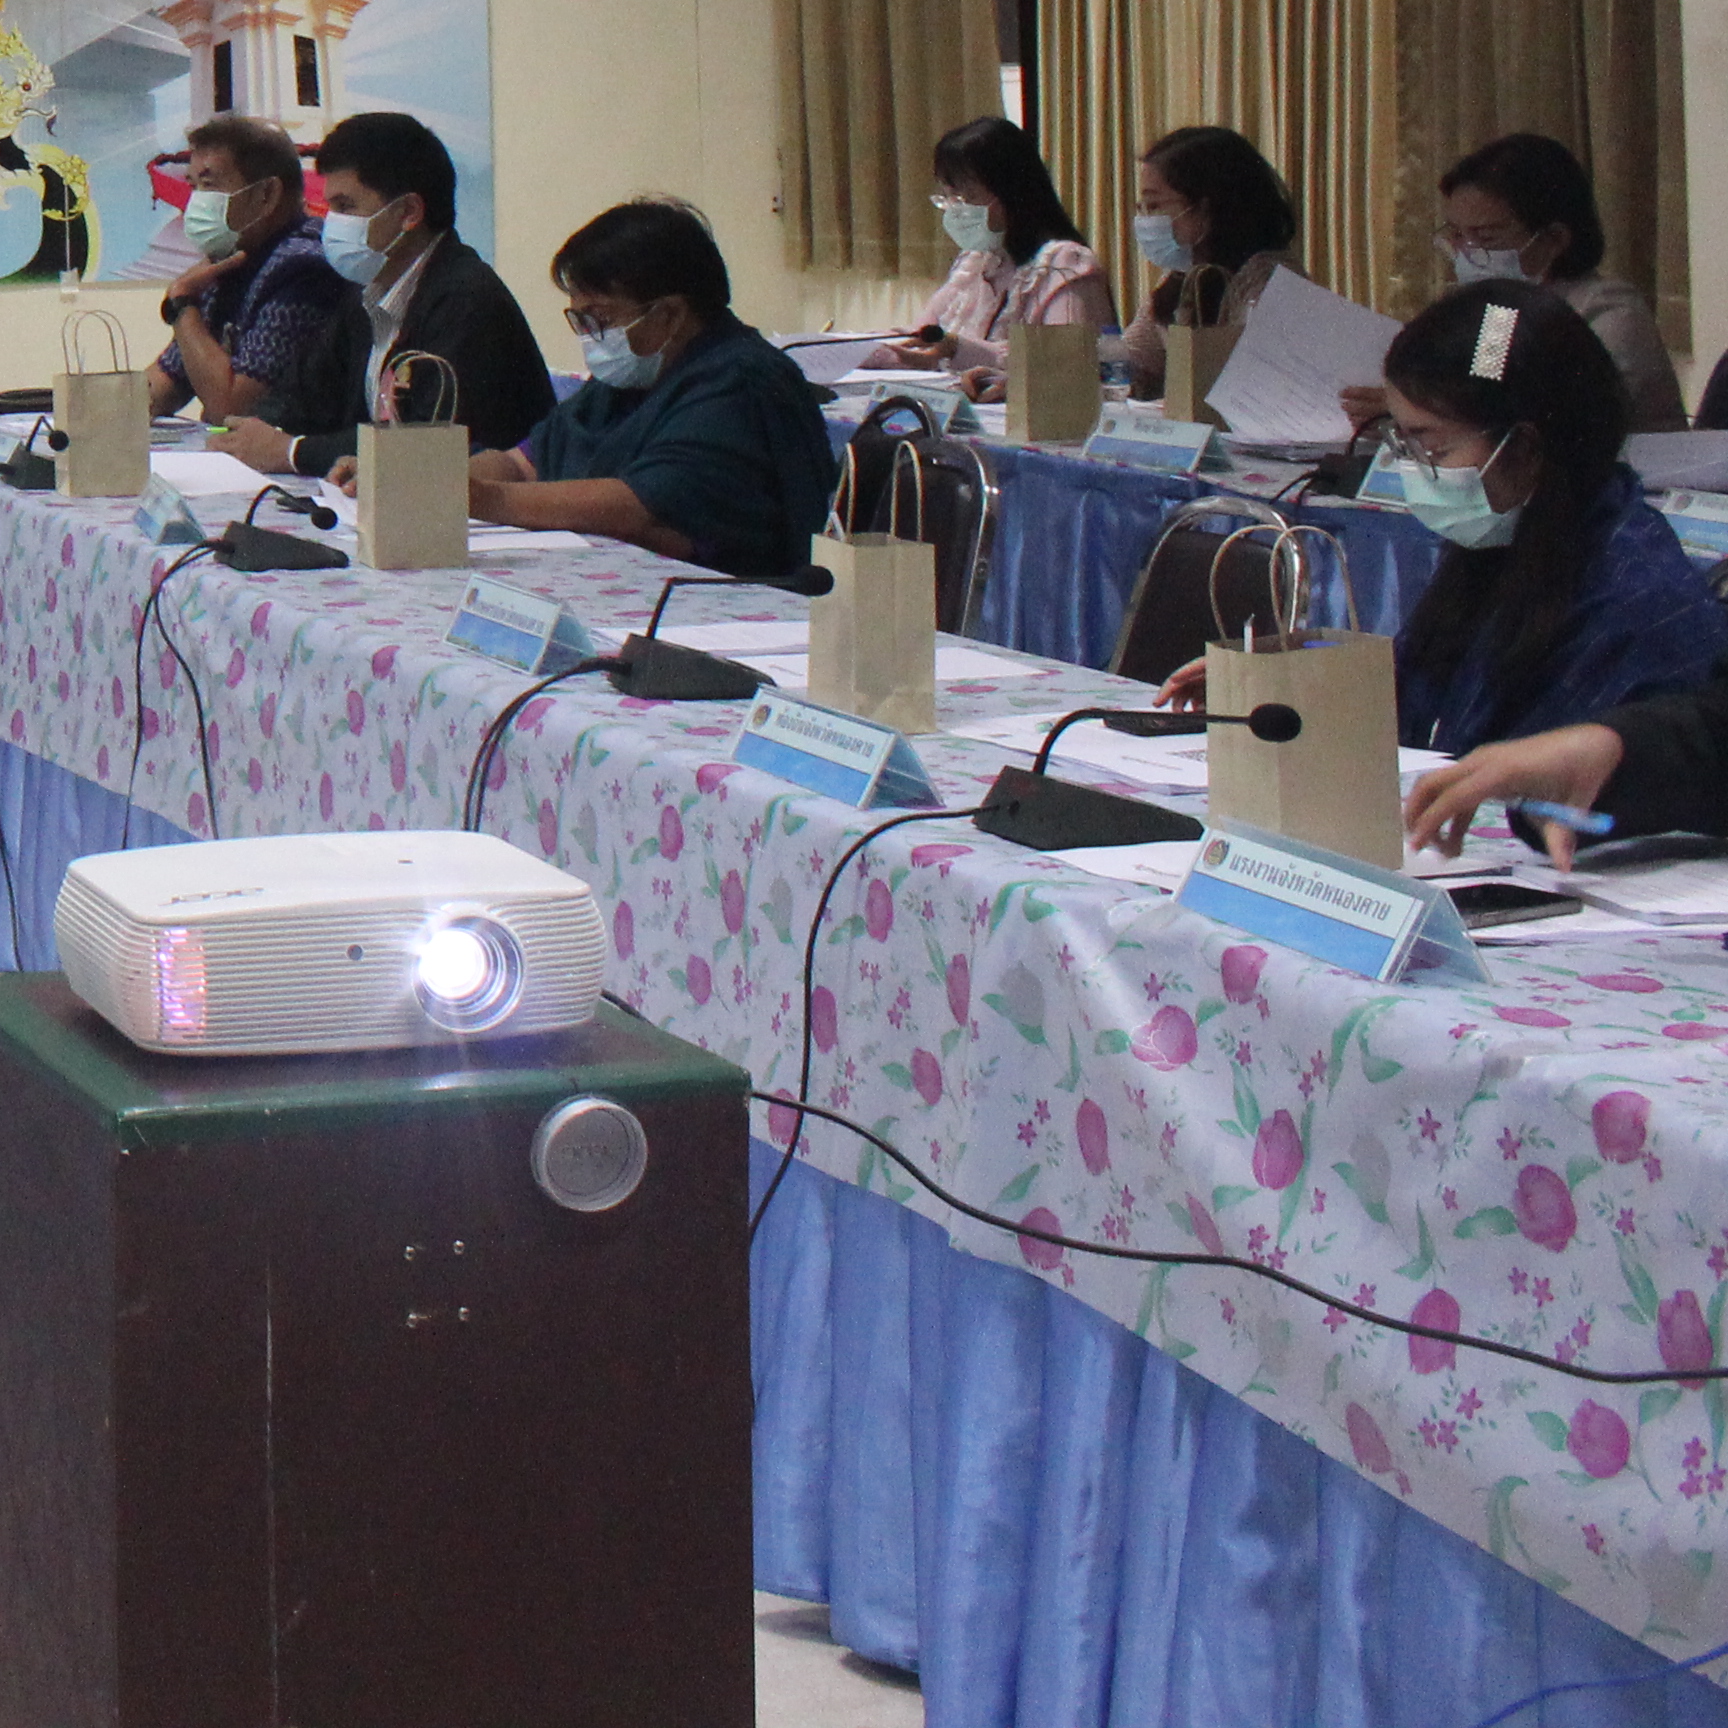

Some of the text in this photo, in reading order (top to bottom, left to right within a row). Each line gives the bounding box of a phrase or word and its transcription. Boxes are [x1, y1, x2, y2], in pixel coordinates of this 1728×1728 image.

[1229, 853, 1392, 922] แรงงานจังหวัดหนองคาย
